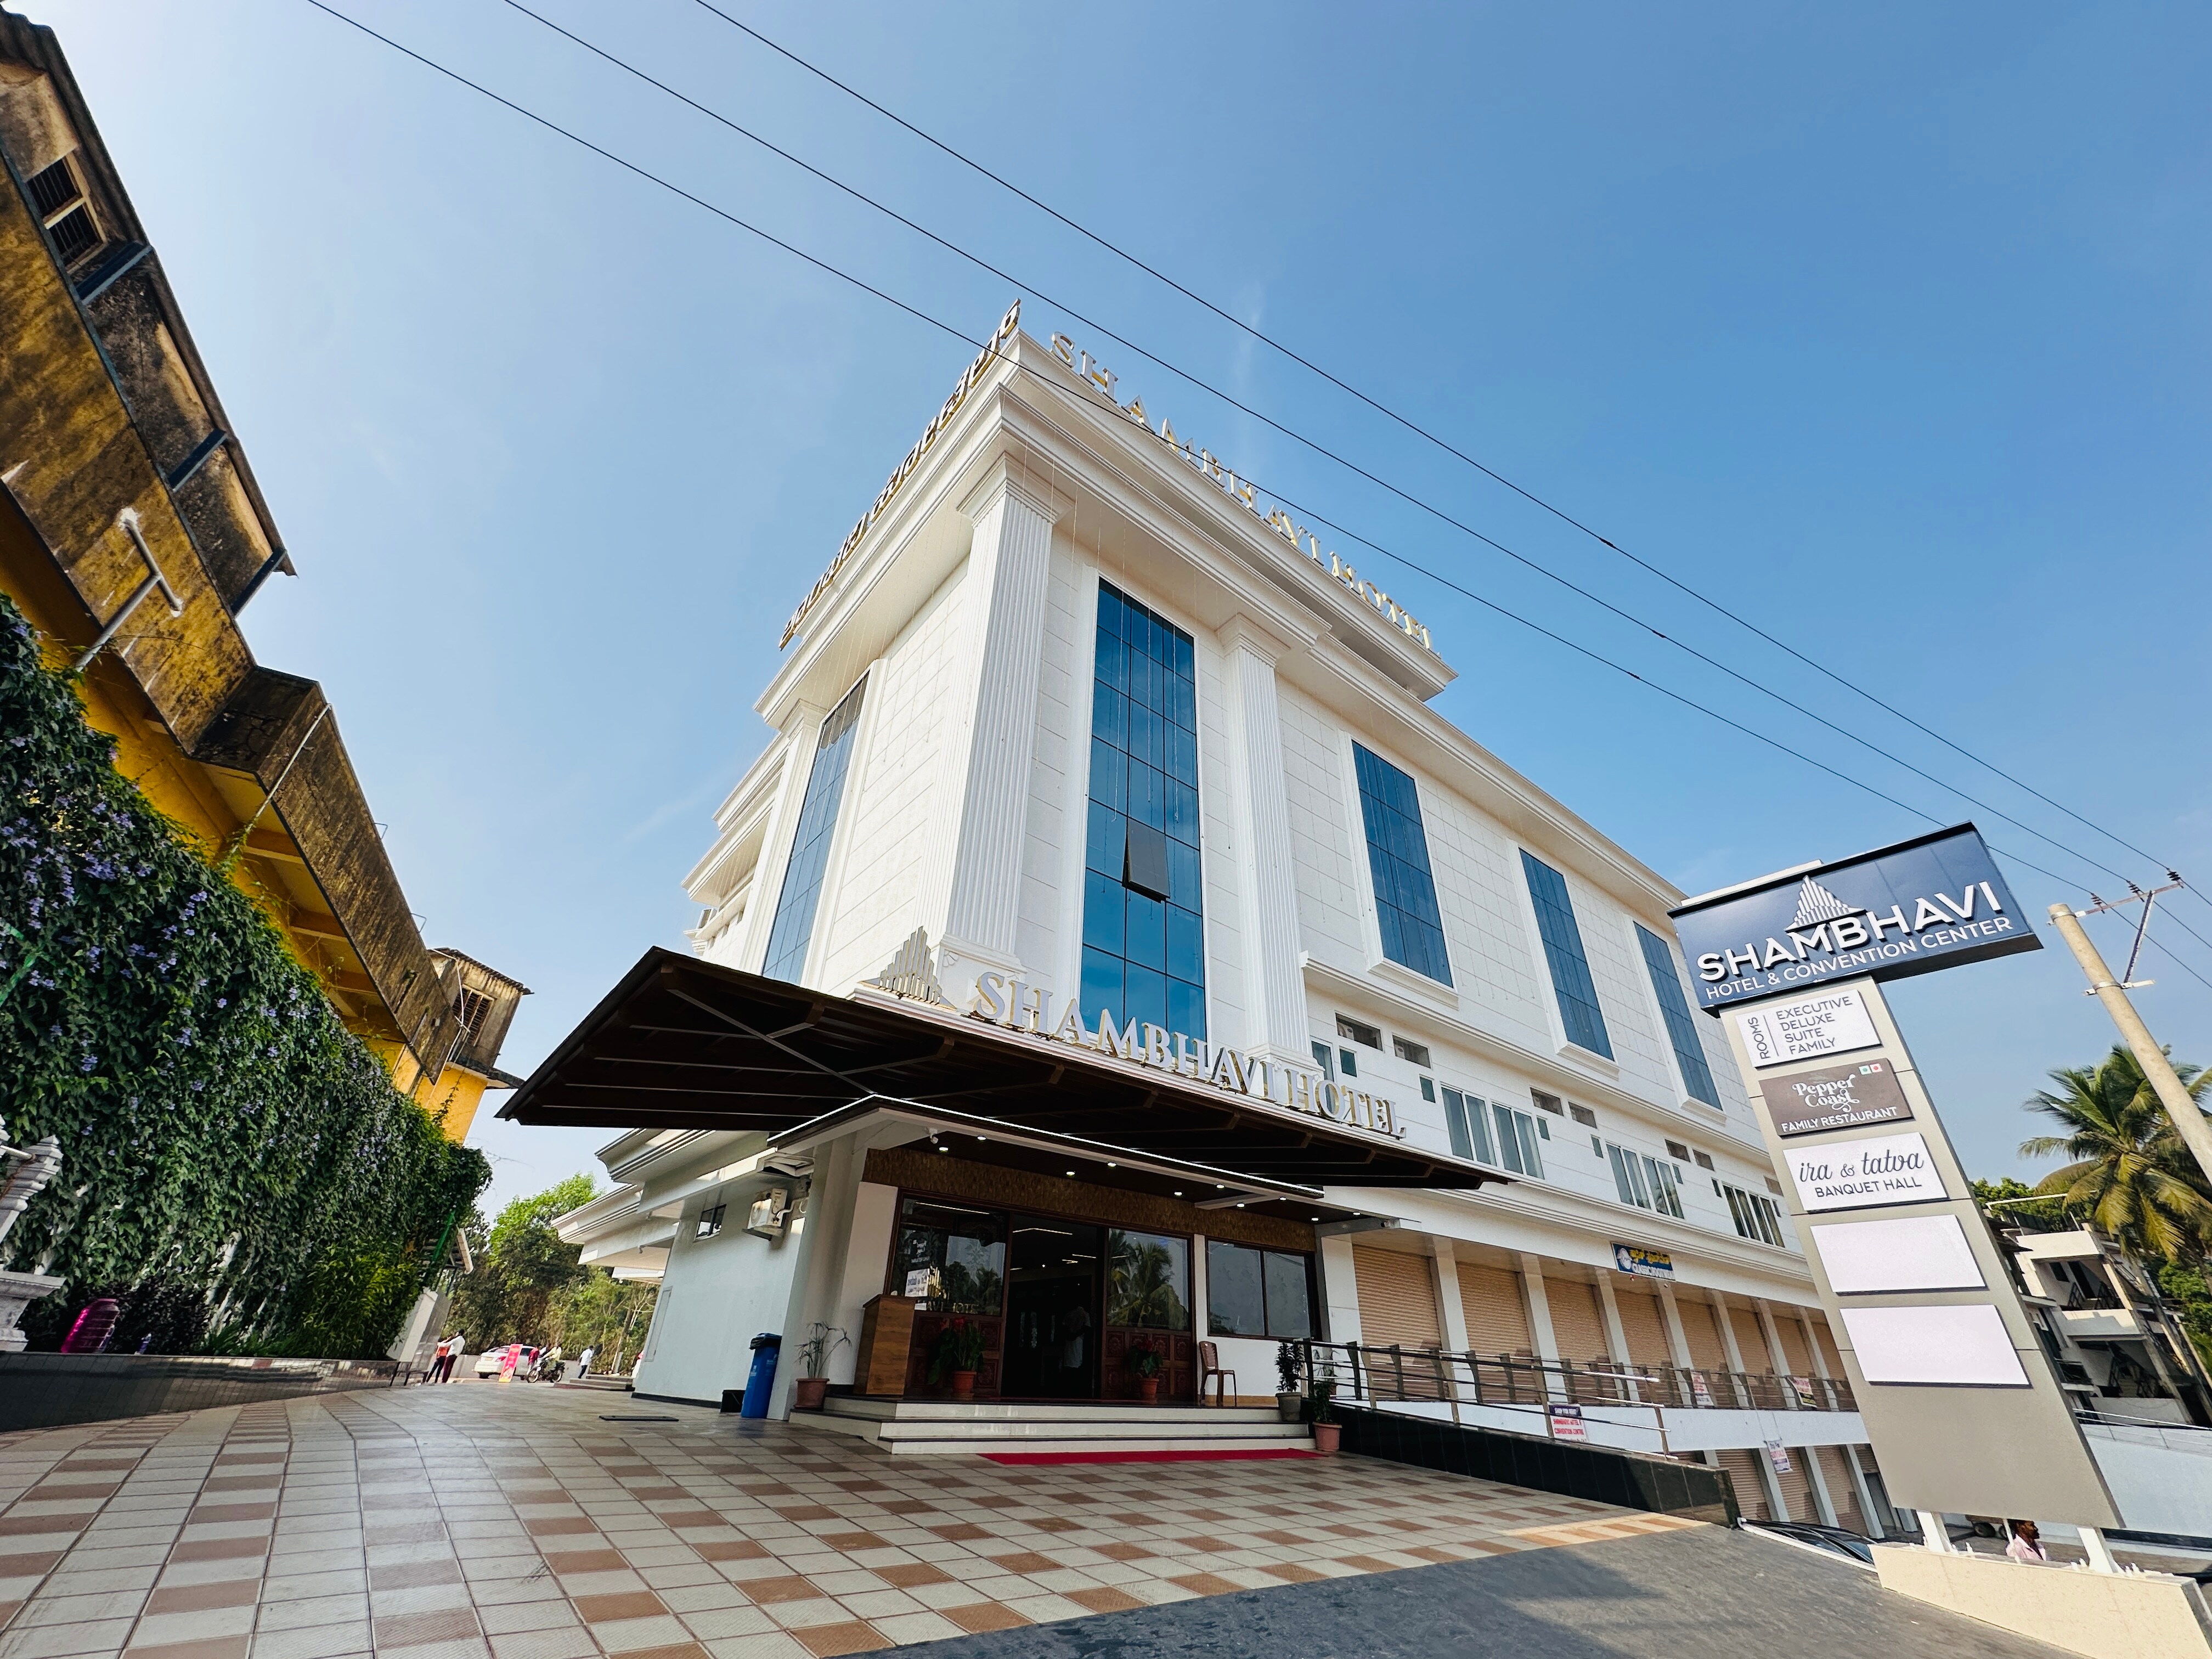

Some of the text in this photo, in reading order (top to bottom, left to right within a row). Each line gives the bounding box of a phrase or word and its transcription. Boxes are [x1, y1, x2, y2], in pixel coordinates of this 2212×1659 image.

[1050, 331, 1442, 660] SHAMBHAVI HOTEL
[1697, 881, 2002, 981] SHAMBHAVI
[1705, 916, 2013, 1000] HOTEL & CONVENTION CENTER
[1776, 996, 1853, 1020] EXECUTIVE
[1780, 1013, 1836, 1031] DELUXE
[1748, 1017, 1771, 1059] ROOMS
[1785, 1028, 1825, 1043] SUITE
[1789, 1037, 1836, 1054] FAMILY
[973, 972, 1407, 1139] SHAMBHAVI HOTEL
[1792, 1074, 1857, 1097] Pepper
[1804, 1088, 1860, 1113] Coast
[1781, 1106, 1897, 1132] FAMILY RESTAURANT
[1799, 1149, 1925, 1182] ira & tatva
[1815, 1177, 1922, 1198] BANQUET HALL
